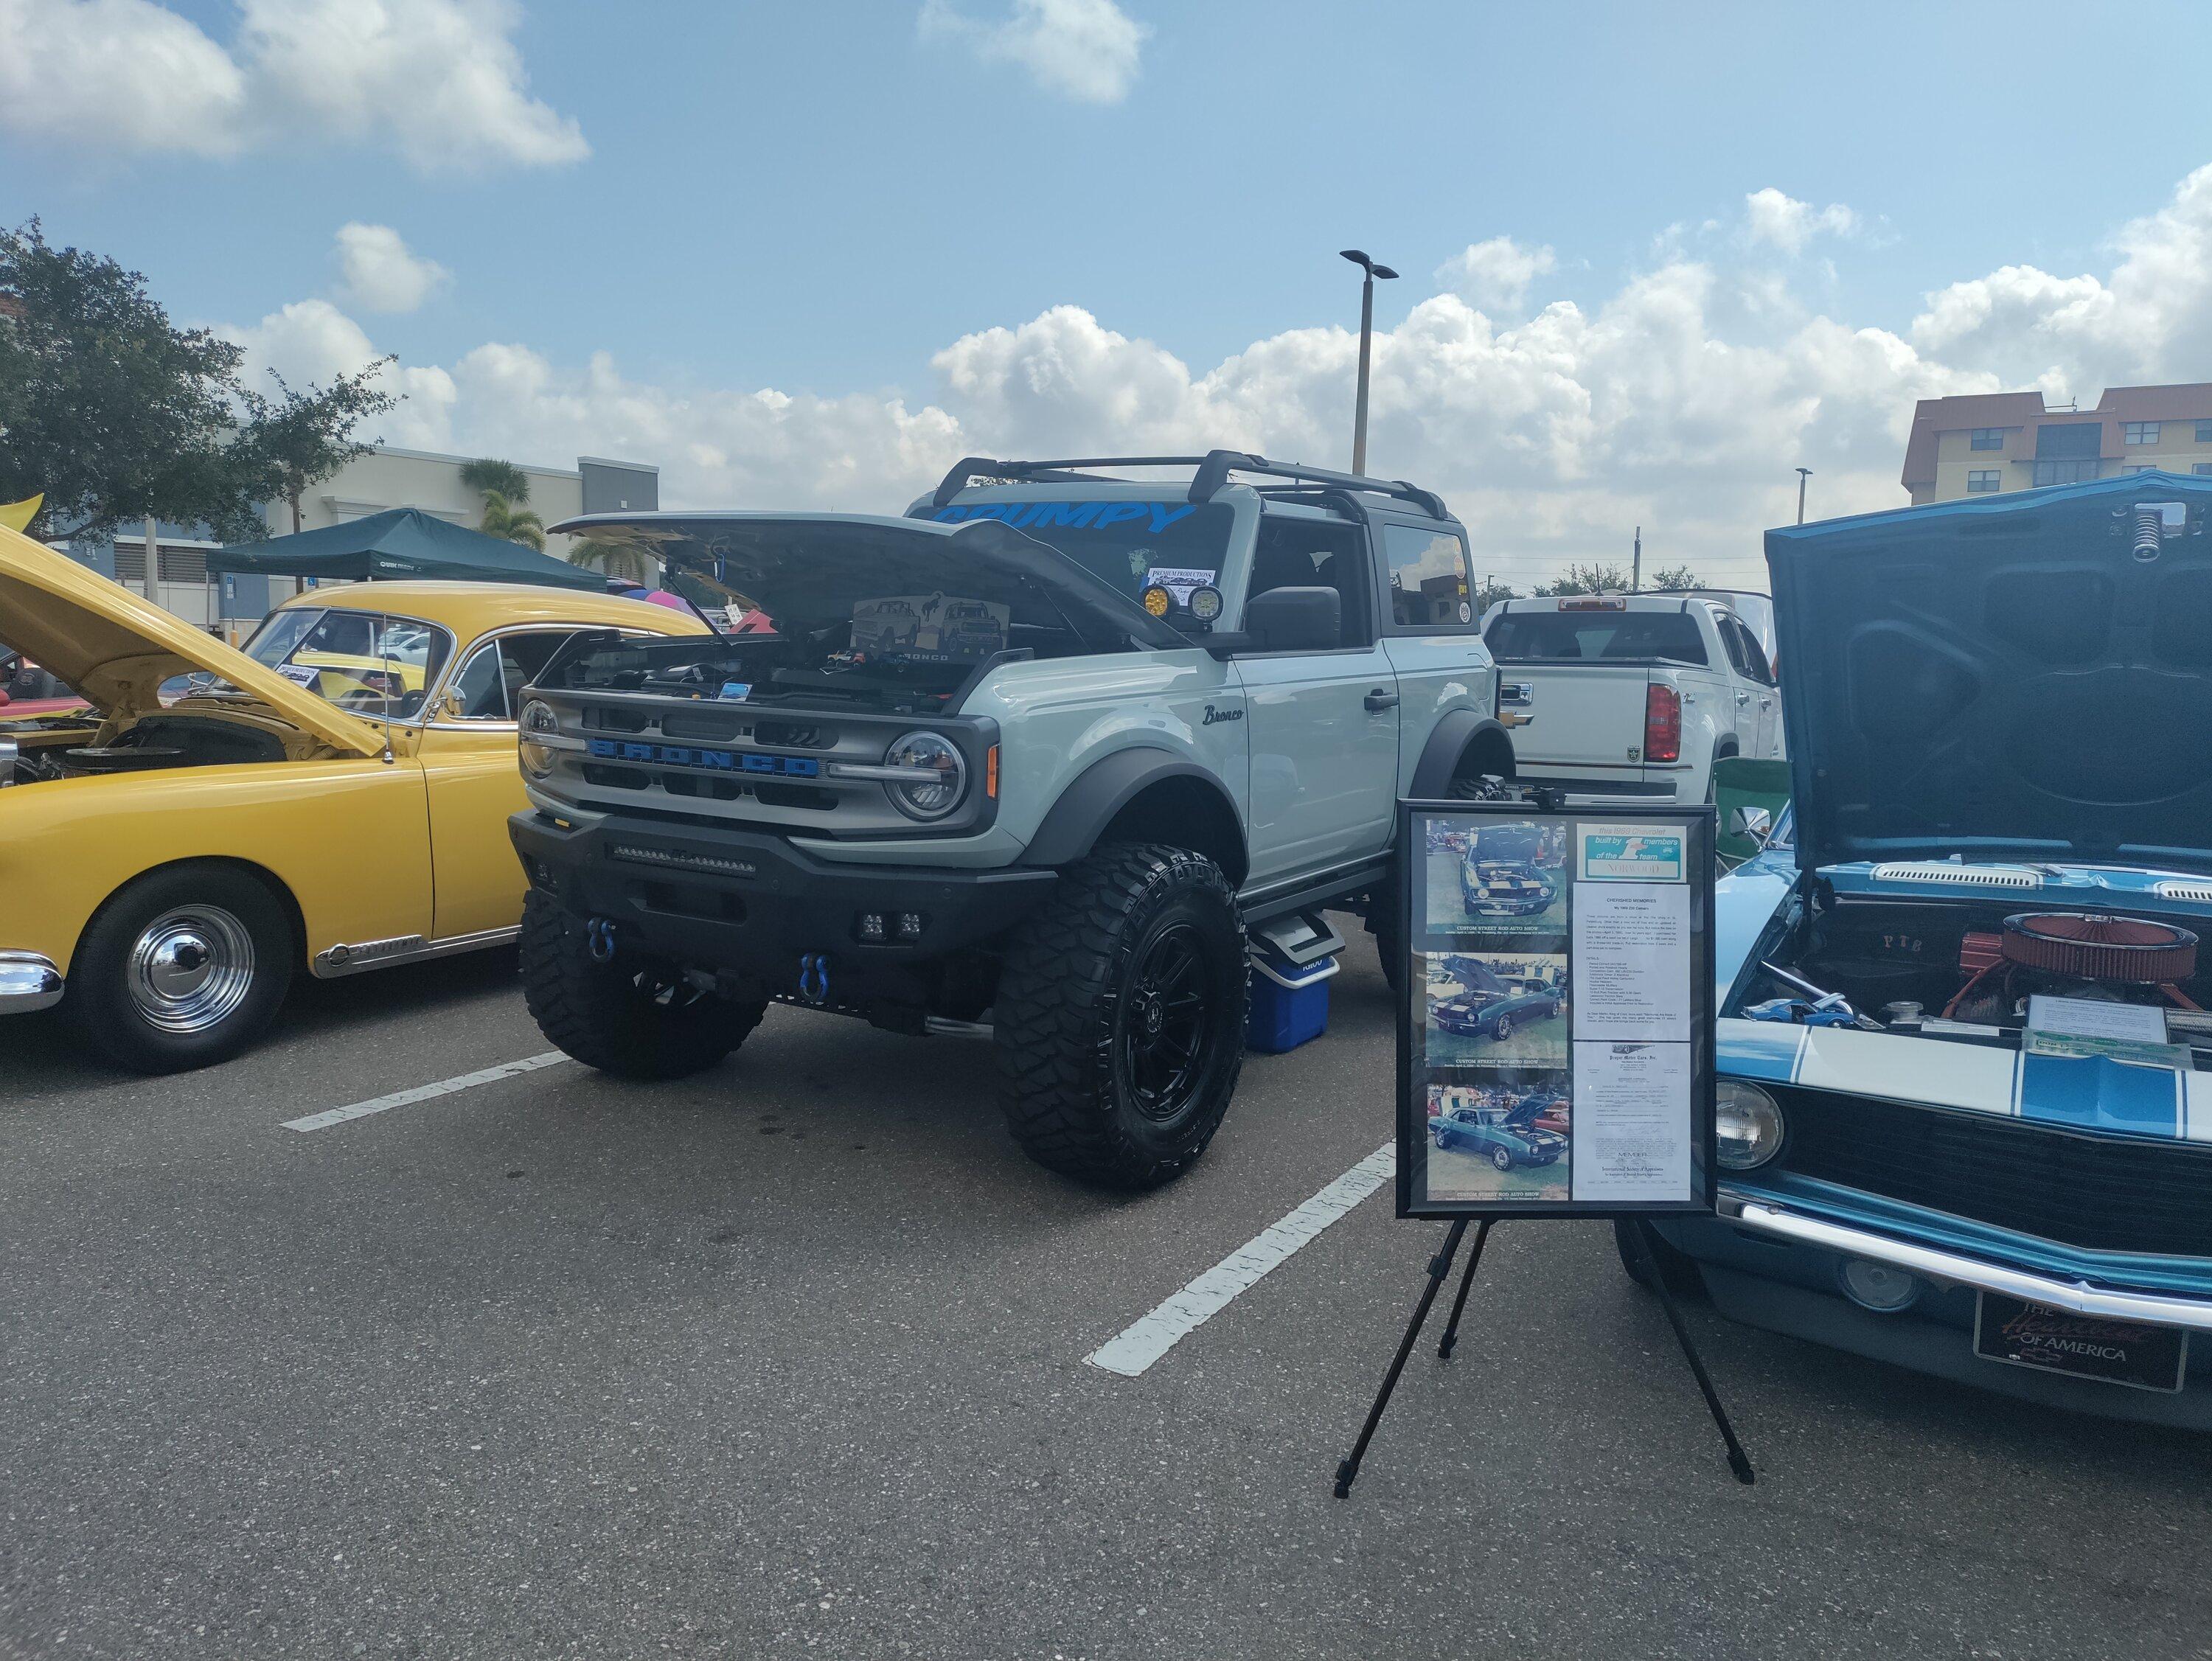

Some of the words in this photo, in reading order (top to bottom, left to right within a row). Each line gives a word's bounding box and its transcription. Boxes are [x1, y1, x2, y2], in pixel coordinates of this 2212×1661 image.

[1177, 571, 1211, 579] PRODUCTIONS
[1203, 705, 1245, 725] Bronco
[589, 739, 820, 776] BRONCO
[1608, 863, 1659, 874] NORWOOD
[2020, 1332, 2044, 1345] OF
[2045, 1337, 2126, 1362] AMERICA
